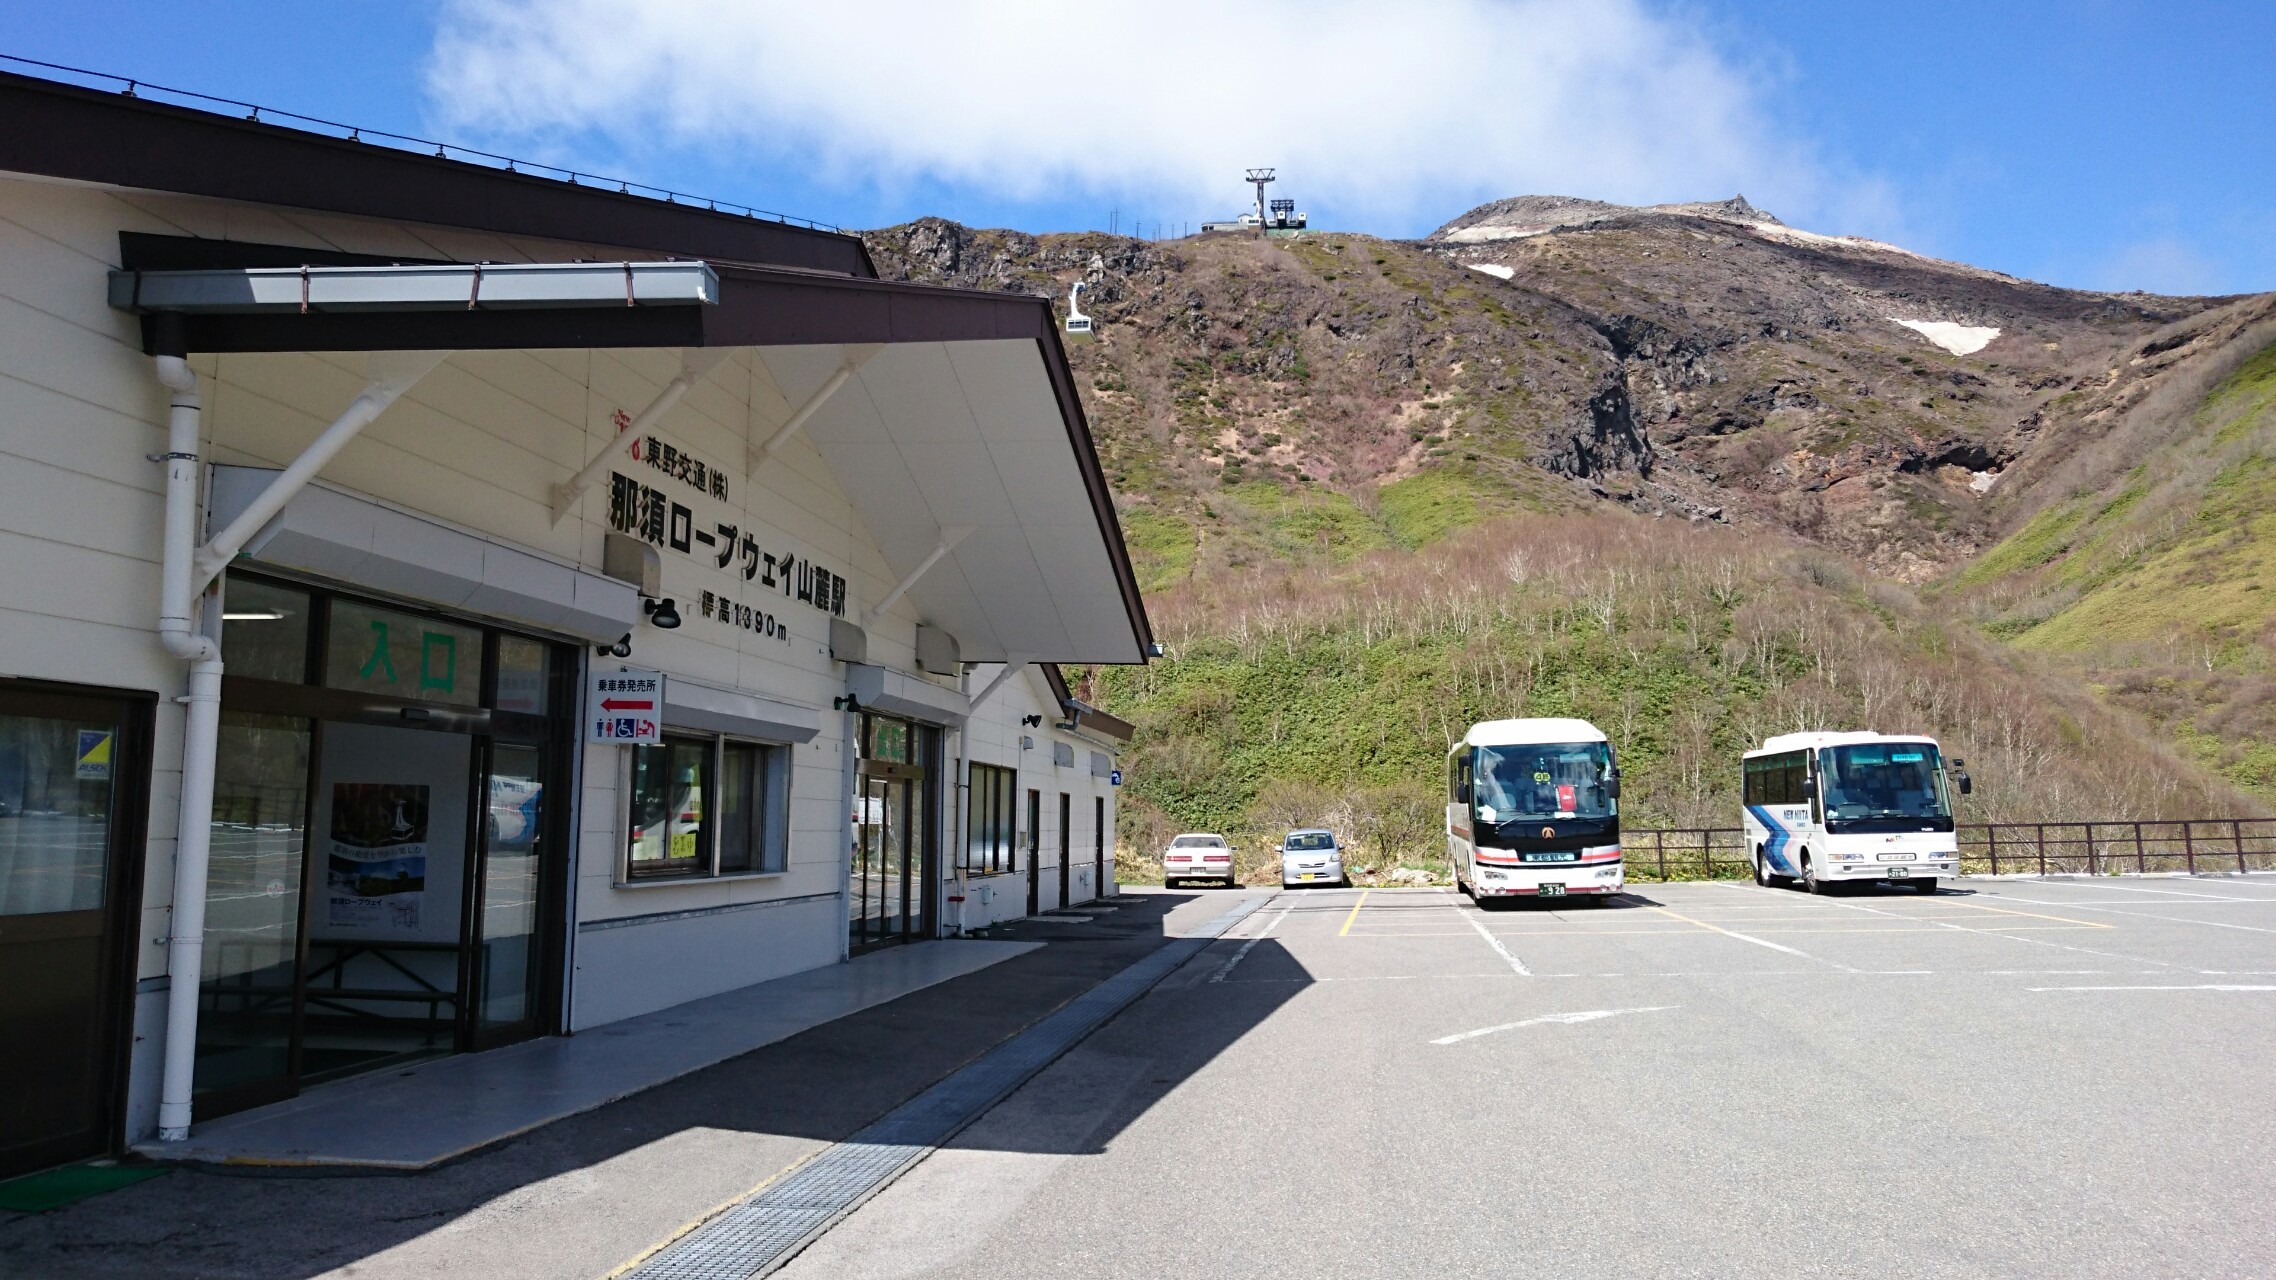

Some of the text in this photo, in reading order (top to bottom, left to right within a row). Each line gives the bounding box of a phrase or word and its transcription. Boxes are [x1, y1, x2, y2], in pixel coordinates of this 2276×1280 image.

[646, 436, 728, 503] 東野交通(株)
[610, 471, 846, 618] 那須ロープウェイ山麓駅
[701, 589, 787, 641] 標高1390m
[360, 620, 455, 694] 入口
[597, 679, 657, 693] 乗車券発売所
